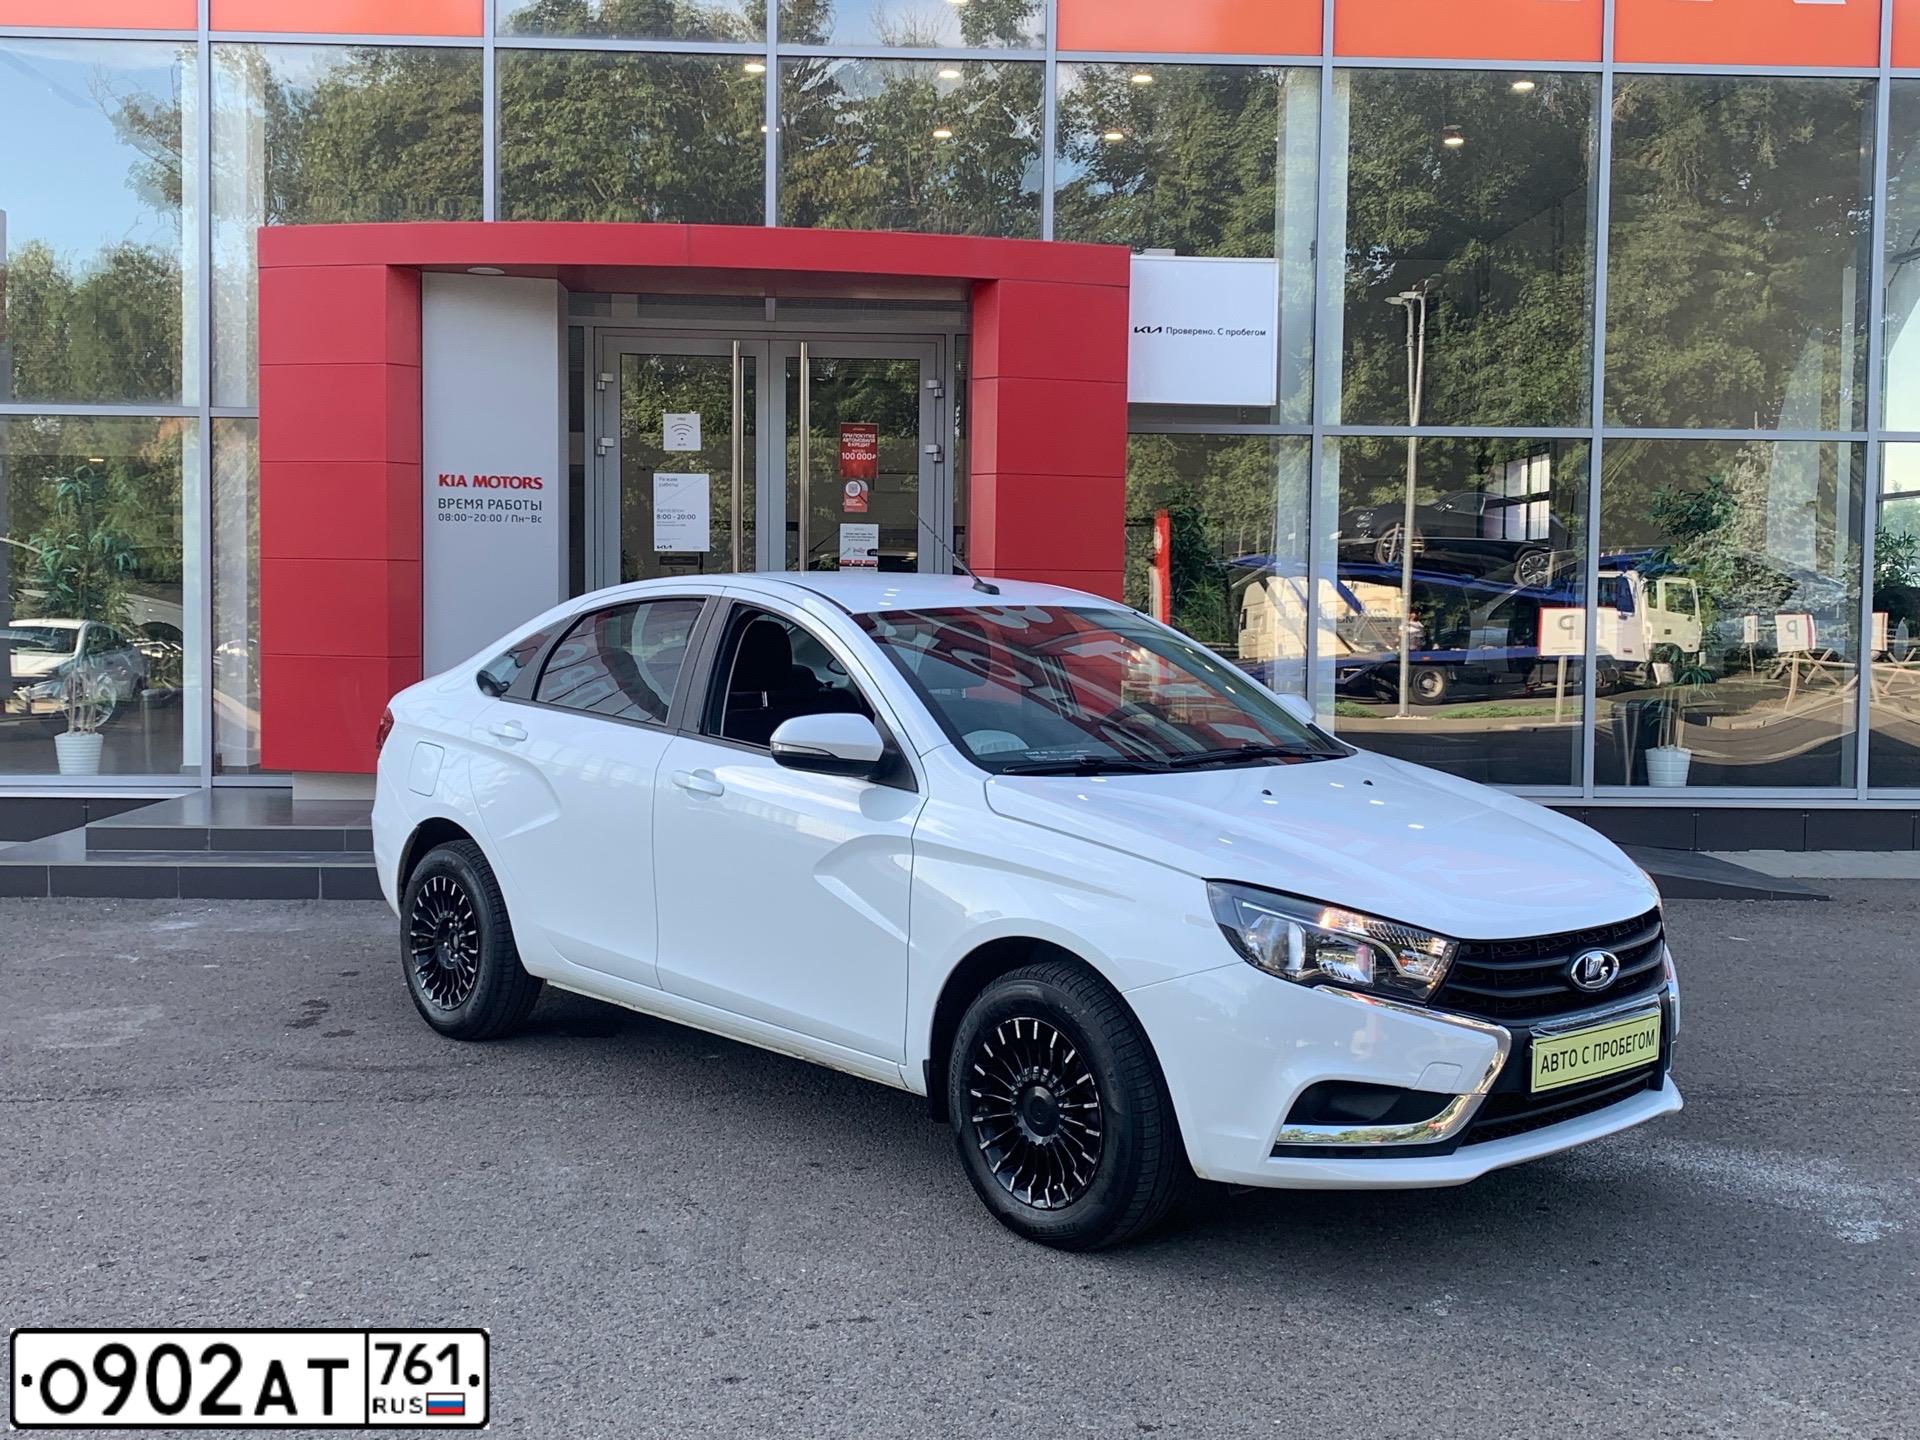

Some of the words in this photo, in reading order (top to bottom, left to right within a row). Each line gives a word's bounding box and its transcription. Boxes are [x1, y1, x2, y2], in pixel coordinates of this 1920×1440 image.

[1166, 326, 1216, 336] Проверено.
[1217, 327, 1224, 336] С
[1225, 328, 1267, 337] пробегом
[842, 452, 856, 460] 100
[438, 474, 468, 487] KIA
[472, 475, 544, 490] MOTORS
[438, 498, 483, 510] ВРЕМЯ
[487, 499, 542, 511] РАБОТЫ
[1540, 1048, 1578, 1074] АВТО
[1582, 1046, 1590, 1065] С
[1593, 1028, 1656, 1063] ПРОБЕГОМ
